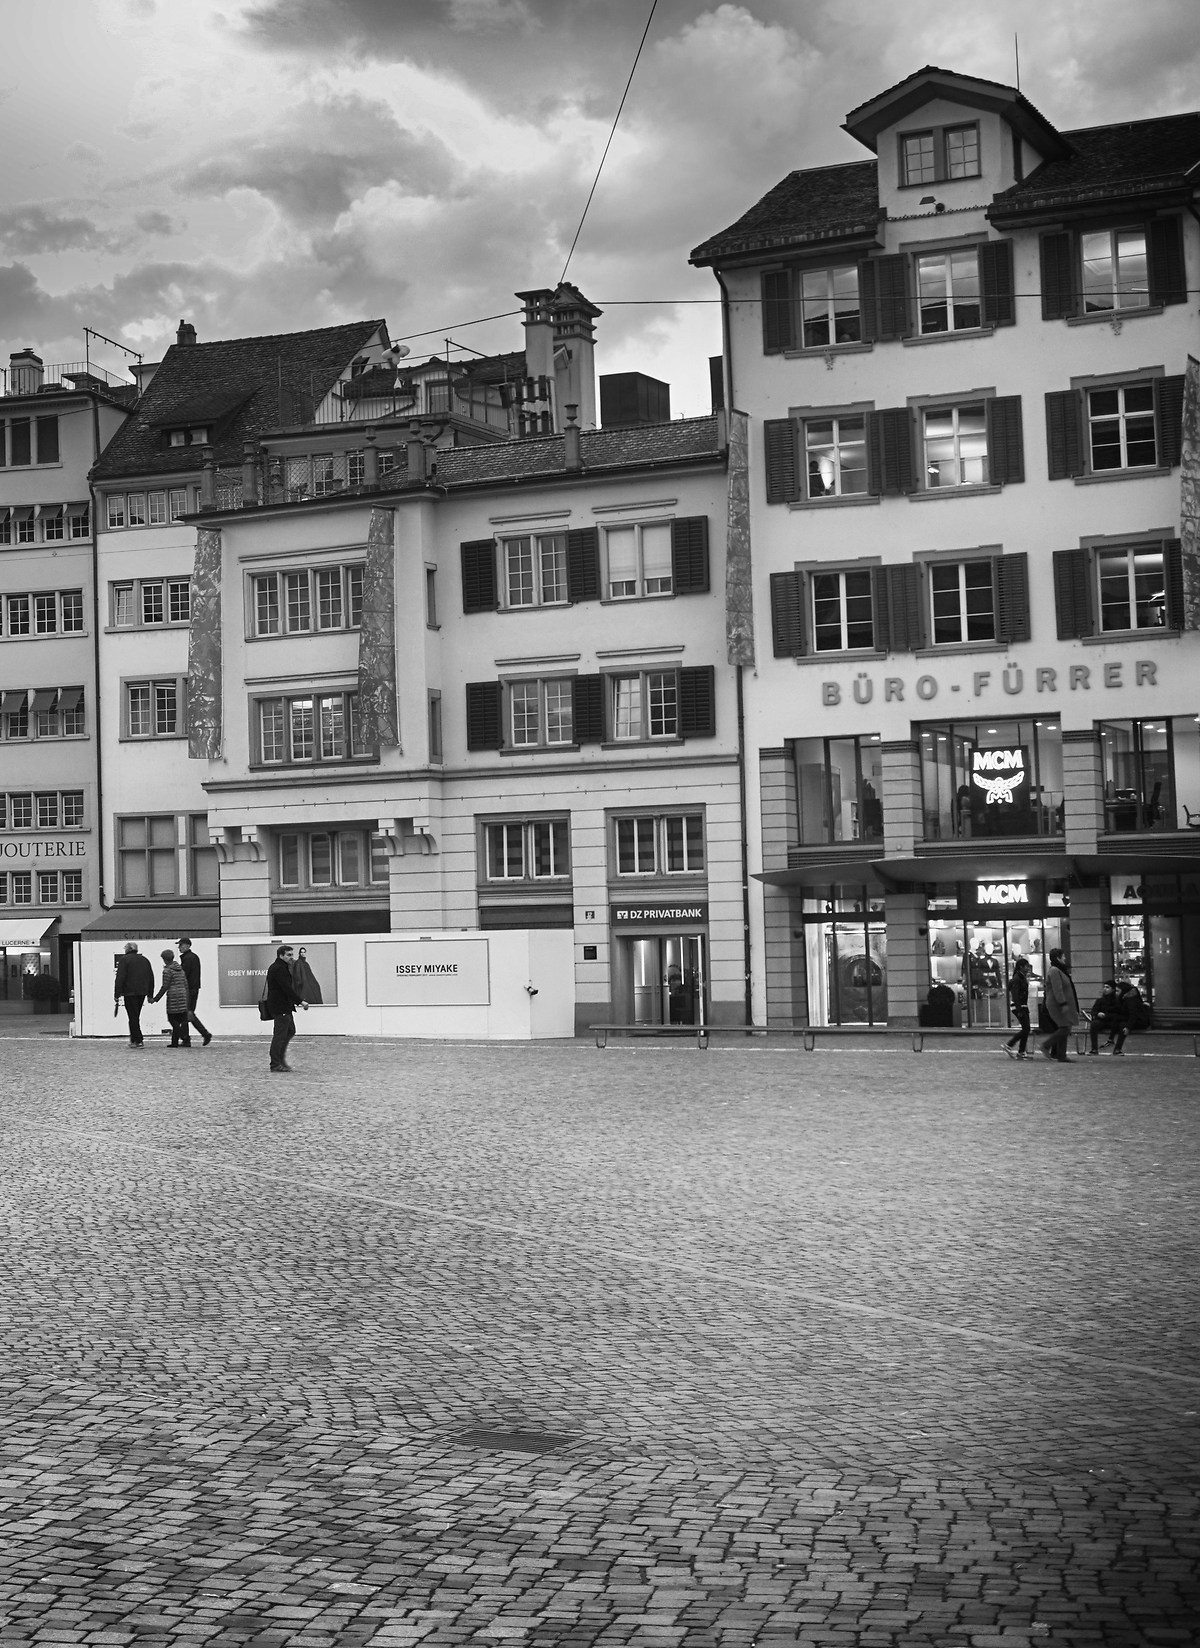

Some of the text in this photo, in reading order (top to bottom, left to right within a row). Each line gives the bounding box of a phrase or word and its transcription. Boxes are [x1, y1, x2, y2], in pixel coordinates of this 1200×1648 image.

[821, 660, 1158, 706] BÜRO-FÜRRER
[972, 749, 1024, 771] MCM
[977, 883, 1029, 904] MCM
[630, 908, 702, 919] DZ PRIVATBANK
[227, 969, 246, 977] ISSEY
[396, 964, 458, 974] ISSEY MIYAKE
